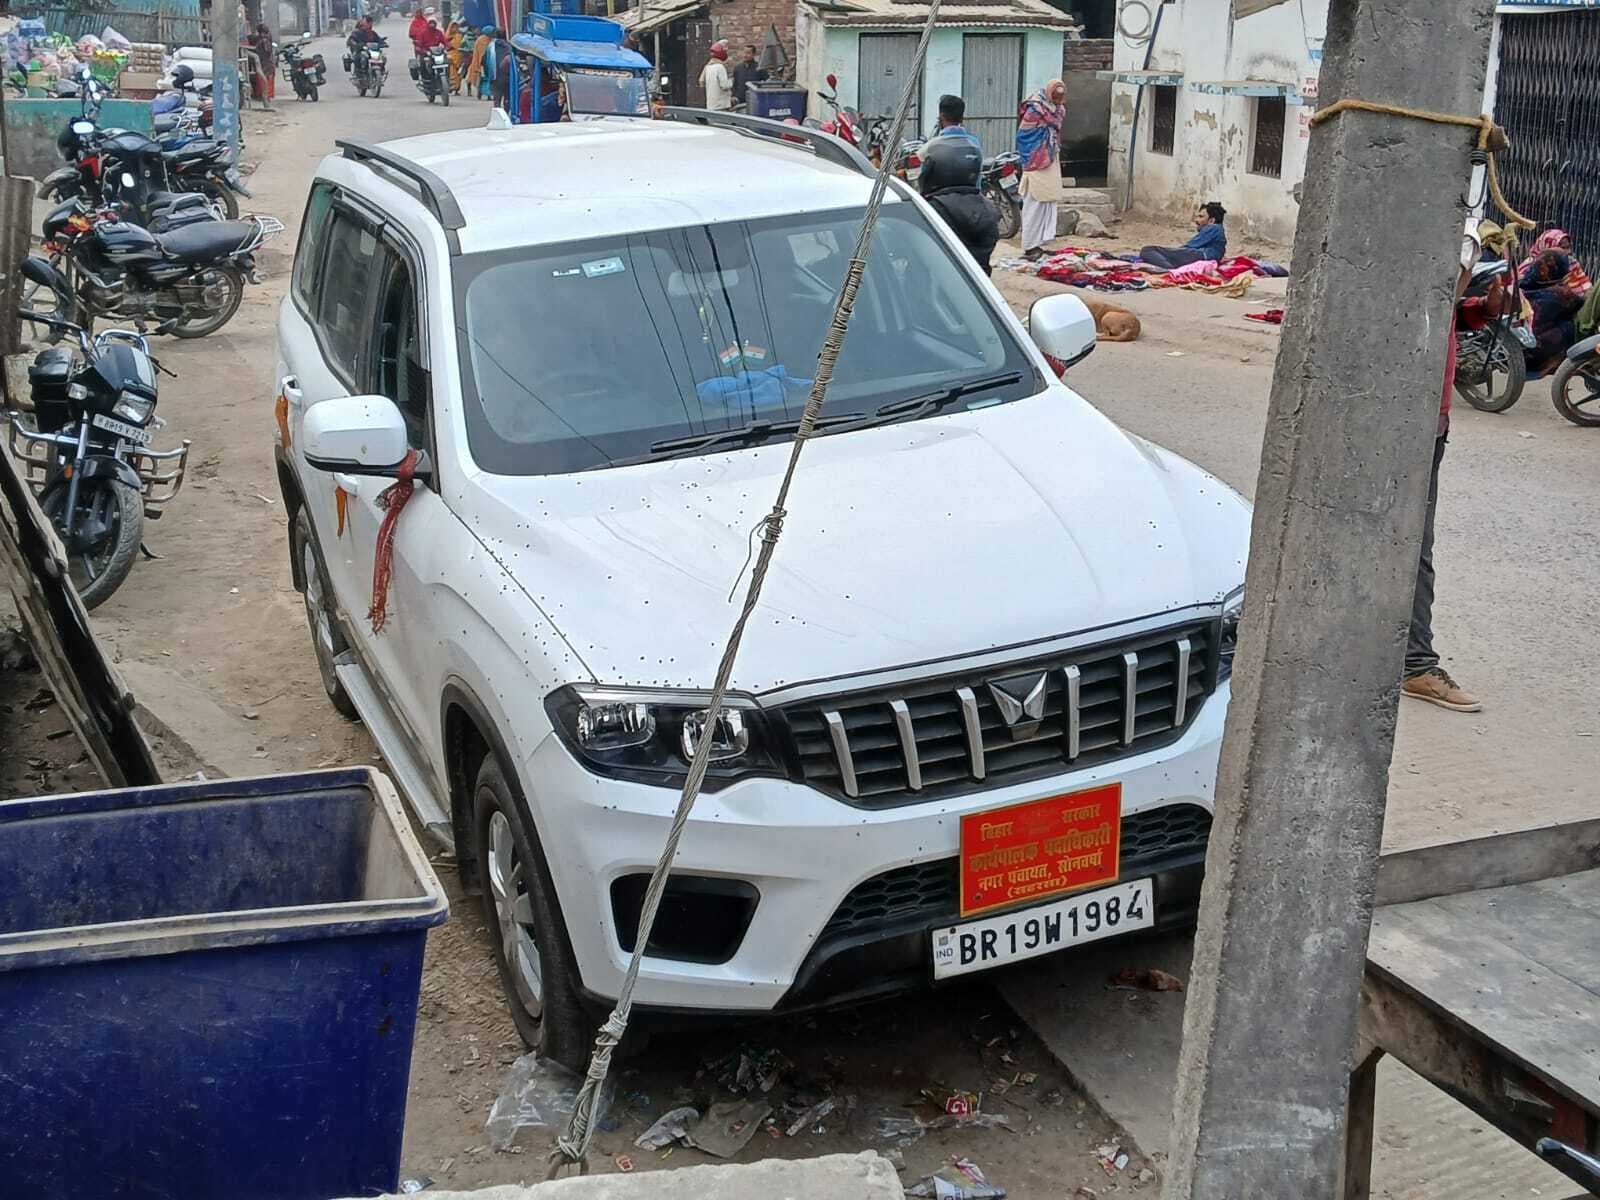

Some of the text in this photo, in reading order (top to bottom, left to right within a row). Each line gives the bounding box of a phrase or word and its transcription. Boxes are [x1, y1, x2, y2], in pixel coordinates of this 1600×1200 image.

[980, 804, 1101, 841] बिहार सरकार
[969, 822, 1112, 872] कार्यपालक पदाधिकारी
[978, 873, 1004, 891] नगर
[936, 948, 953, 959] IND
